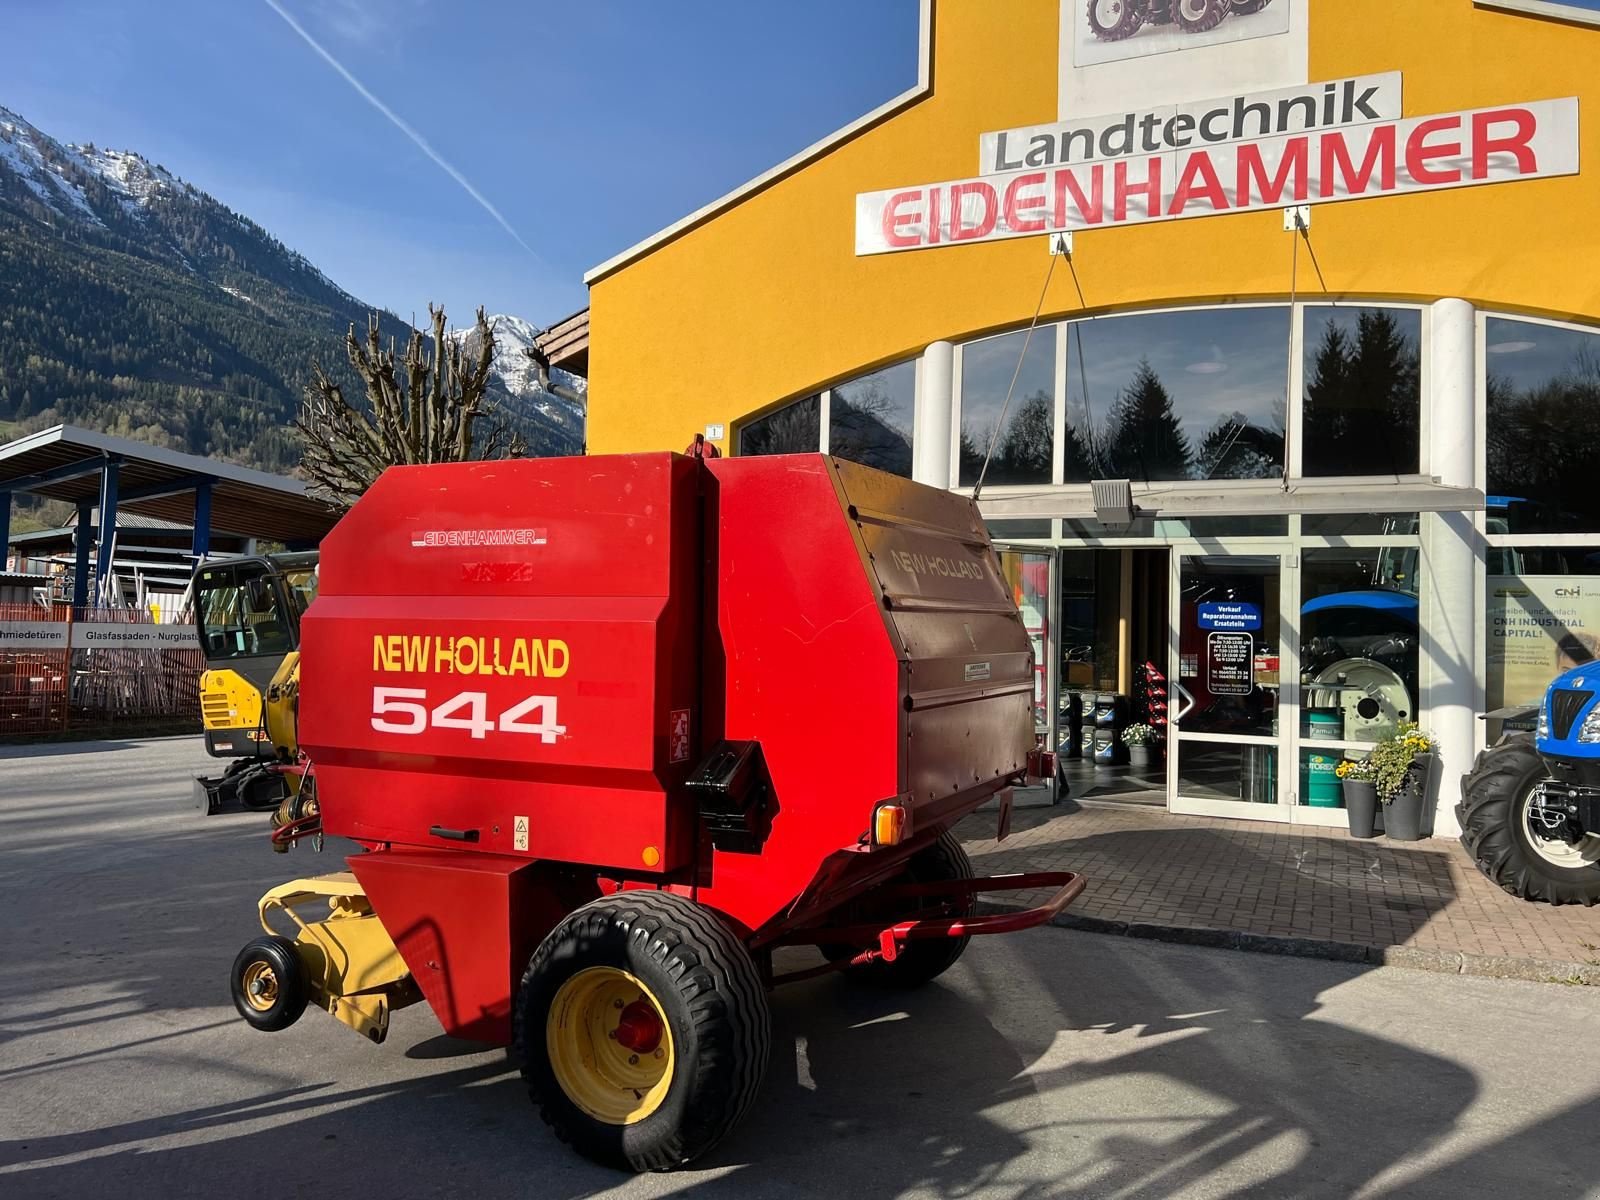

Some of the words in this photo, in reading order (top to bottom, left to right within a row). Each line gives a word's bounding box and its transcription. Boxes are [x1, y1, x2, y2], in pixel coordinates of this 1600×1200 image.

[994, 79, 1382, 172] Landtechnik
[881, 108, 1538, 248] EIDENHAMMER
[424, 530, 535, 545] EIDENHAMMER
[891, 550, 925, 574] NEW
[926, 555, 984, 580] HOLLAND
[1202, 612, 1257, 620] Reparaturannahme
[1494, 617, 1516, 626] CNH
[1519, 618, 1585, 627] INDUSTRIAL
[86, 631, 150, 641] Glasfassaden
[1494, 629, 1543, 638] CAPITAL!
[373, 635, 430, 672] NEW
[434, 636, 570, 678] HOLLAND
[370, 686, 567, 744] 544
